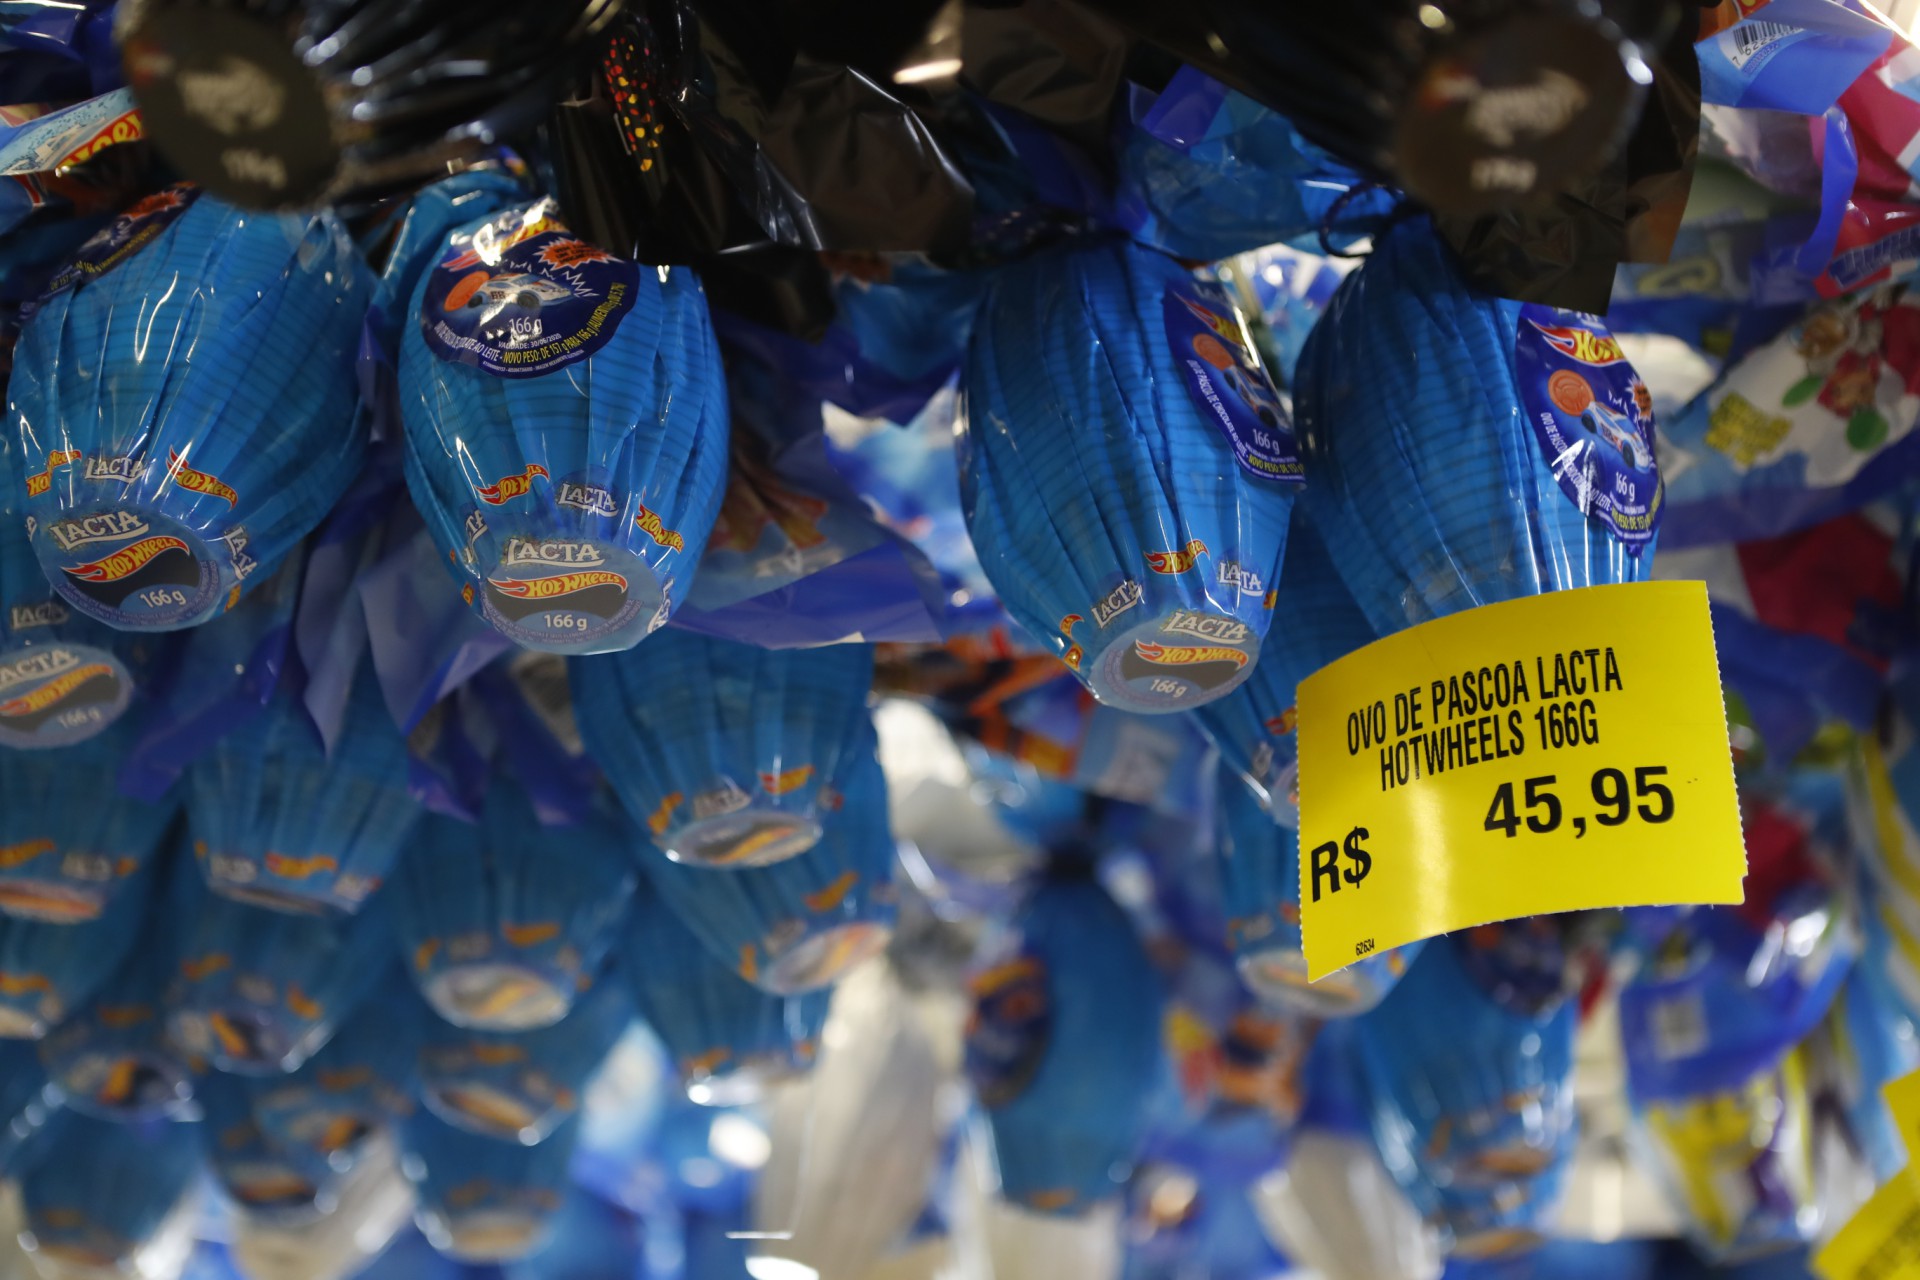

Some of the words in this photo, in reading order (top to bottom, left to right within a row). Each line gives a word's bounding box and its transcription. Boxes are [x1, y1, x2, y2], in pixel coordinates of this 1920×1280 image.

[508, 316, 532, 334] 166
[482, 346, 501, 362] LEITE
[503, 351, 521, 364] NOVO
[523, 348, 542, 363] PESO:
[540, 346, 551, 359] DE
[549, 342, 562, 354] 157
[1253, 428, 1271, 449] 166
[1272, 440, 1280, 455] g
[85, 457, 146, 484] LACTA
[558, 483, 619, 517] LACTA
[1629, 482, 1635, 502] g
[49, 511, 150, 550] LACTA
[507, 538, 606, 568] LACTA
[140, 588, 172, 608] 166
[171, 590, 187, 605] g
[1091, 580, 1143, 629] LACTA
[544, 614, 574, 628] 166
[576, 617, 588, 631] g
[1163, 611, 1248, 645] LACTA
[0, 649, 80, 691] ACTA
[1150, 679, 1178, 693] 166
[1173, 686, 1188, 698] g
[1347, 700, 1386, 756] OVO
[1394, 686, 1424, 737] DE
[1431, 660, 1530, 724] PASCOA
[1537, 647, 1623, 700] LACTA
[1380, 709, 1525, 792] HOTWHEELS
[1534, 699, 1600, 750] 166G
[1483, 766, 1675, 839] 45,95
[1311, 826, 1372, 903] R$
[1355, 938, 1375, 956] 62634
